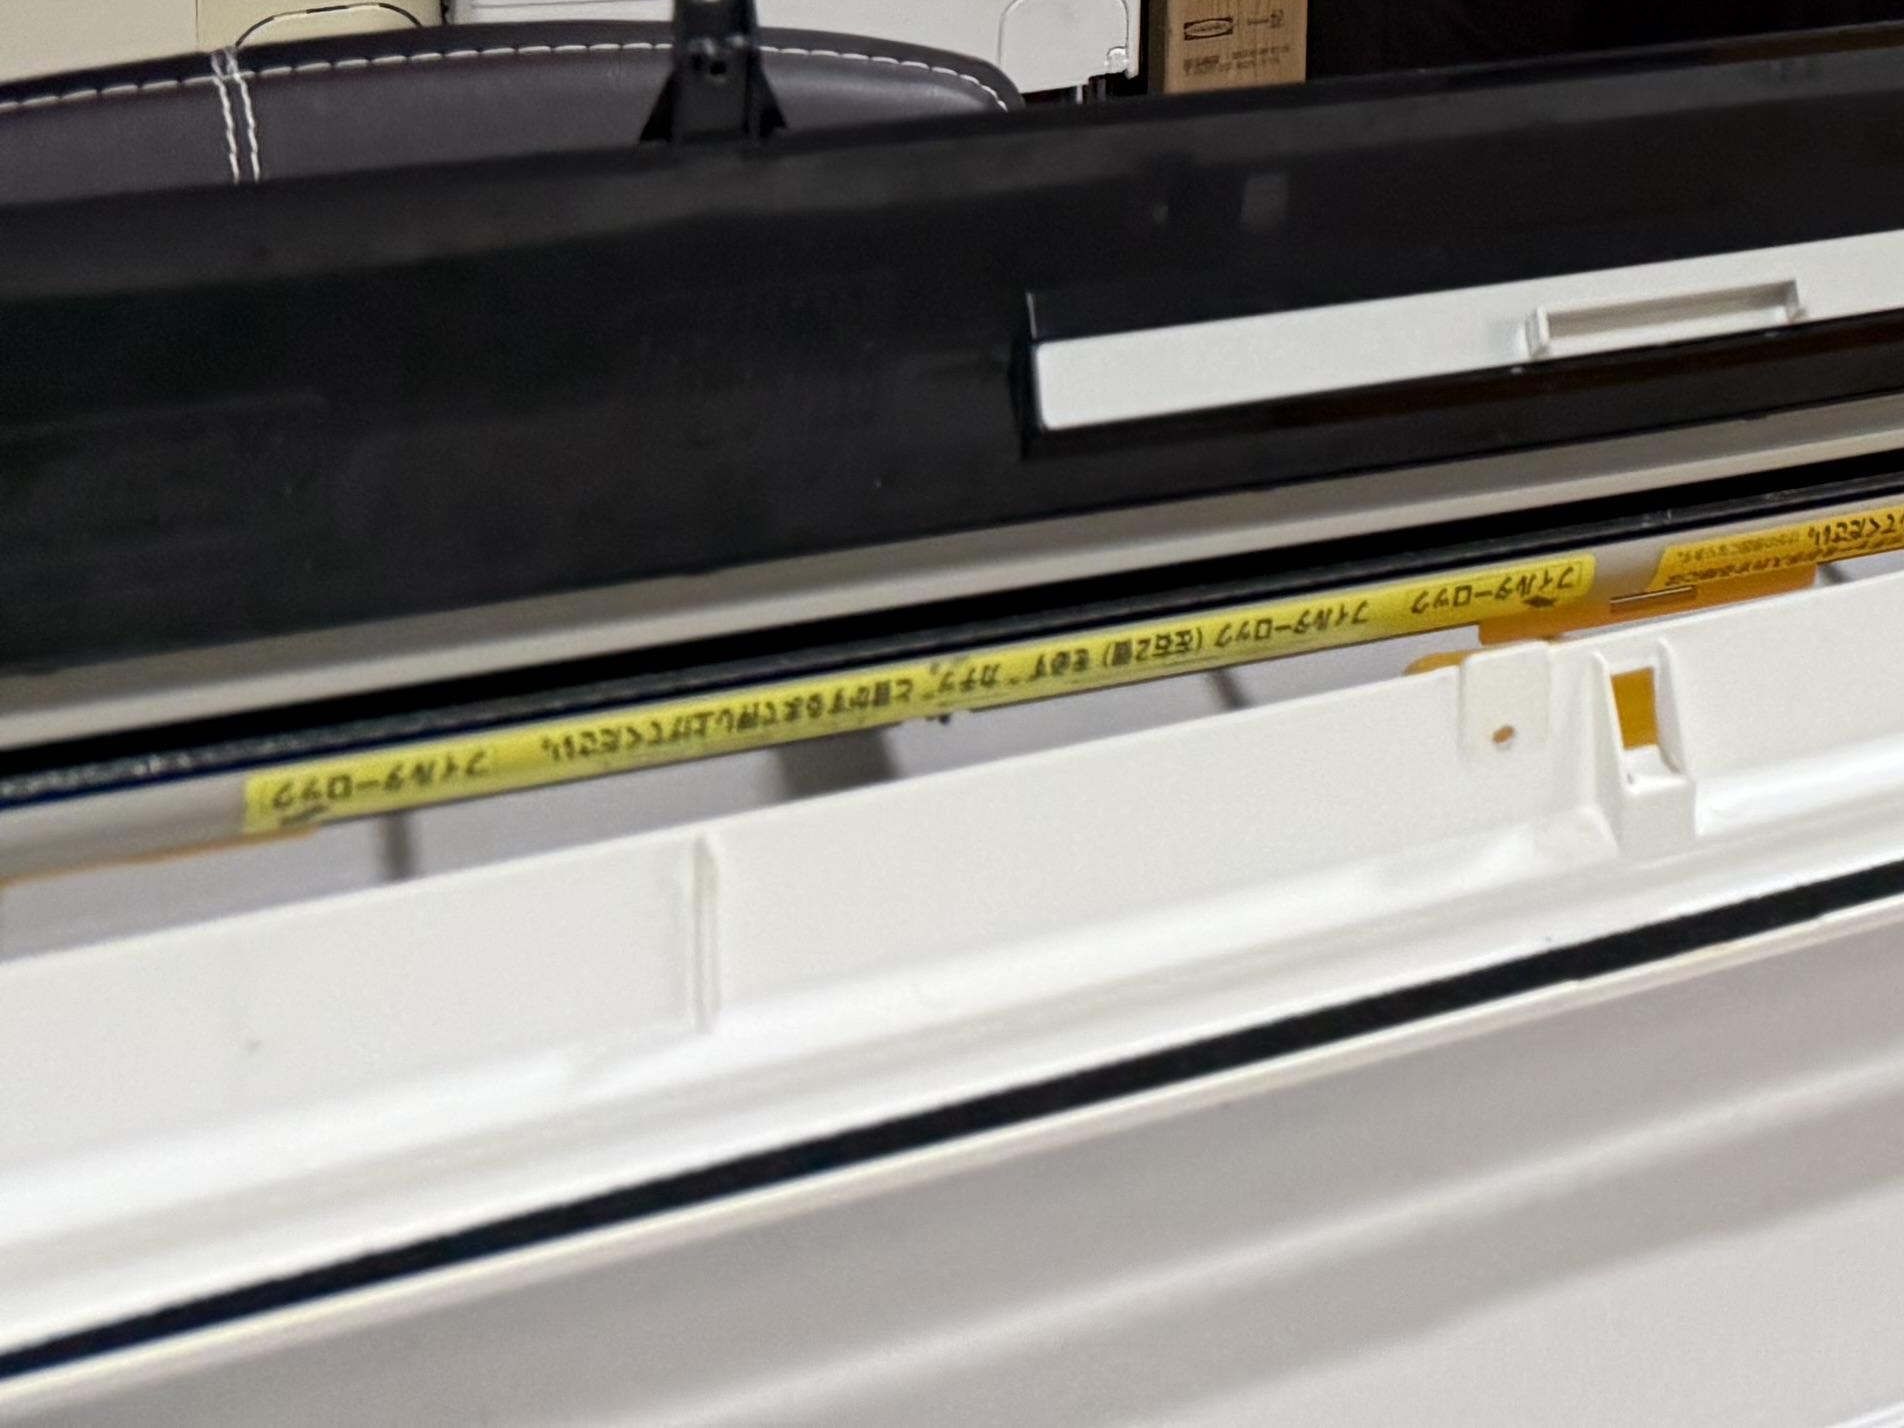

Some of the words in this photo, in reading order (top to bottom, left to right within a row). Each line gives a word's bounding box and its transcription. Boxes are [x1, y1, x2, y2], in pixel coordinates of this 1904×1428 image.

[1411, 567, 1575, 614] フィルターロック
[272, 751, 488, 812] フィルターロック
